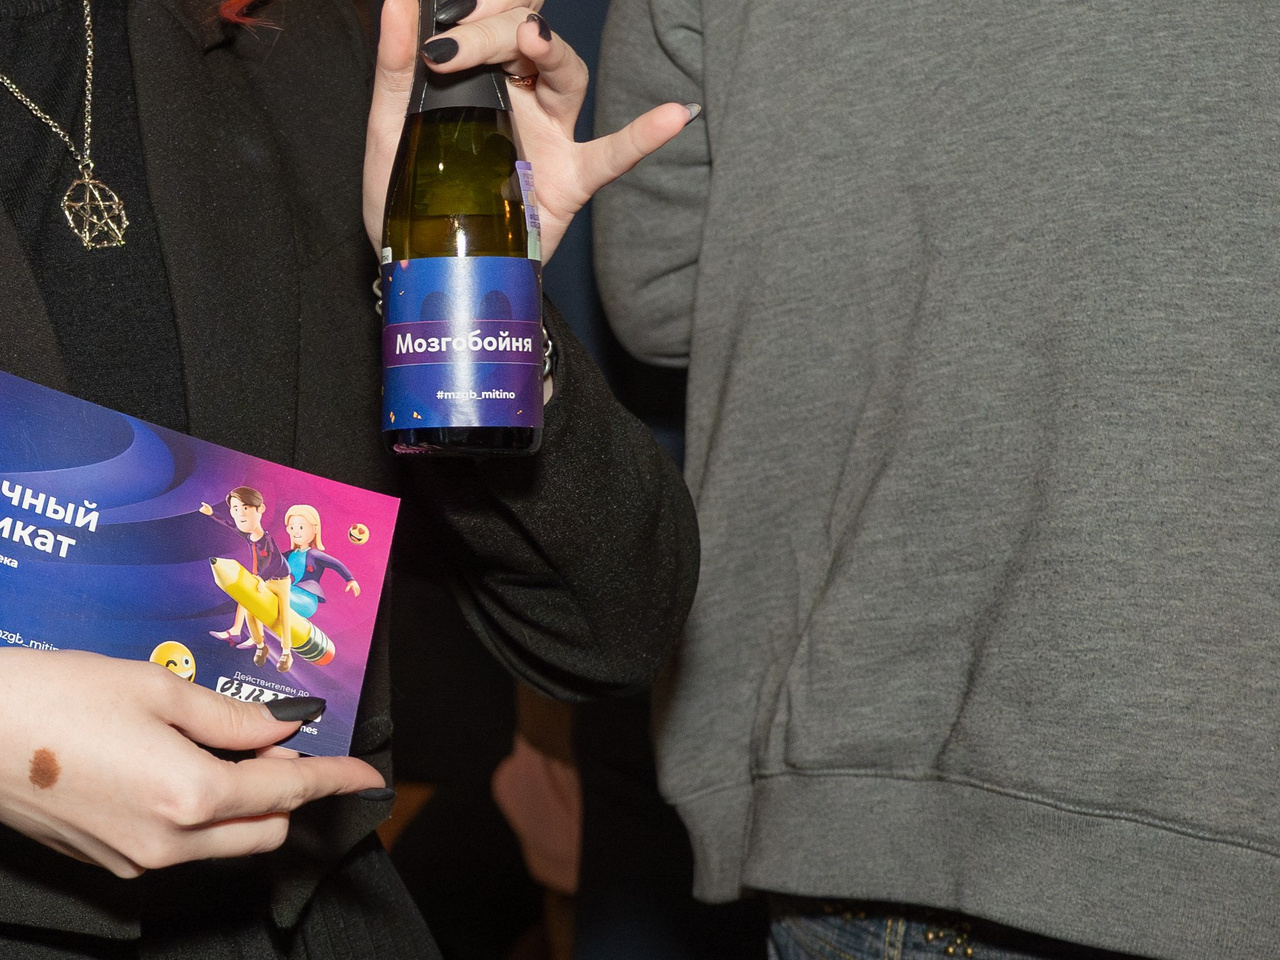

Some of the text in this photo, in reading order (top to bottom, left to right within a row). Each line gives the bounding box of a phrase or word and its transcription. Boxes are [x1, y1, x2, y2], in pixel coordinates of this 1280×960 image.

[395, 329, 532, 355] Мозгобойня
[436, 389, 516, 400] #mzgb_mitino
[233, 671, 310, 698] Действителен до
